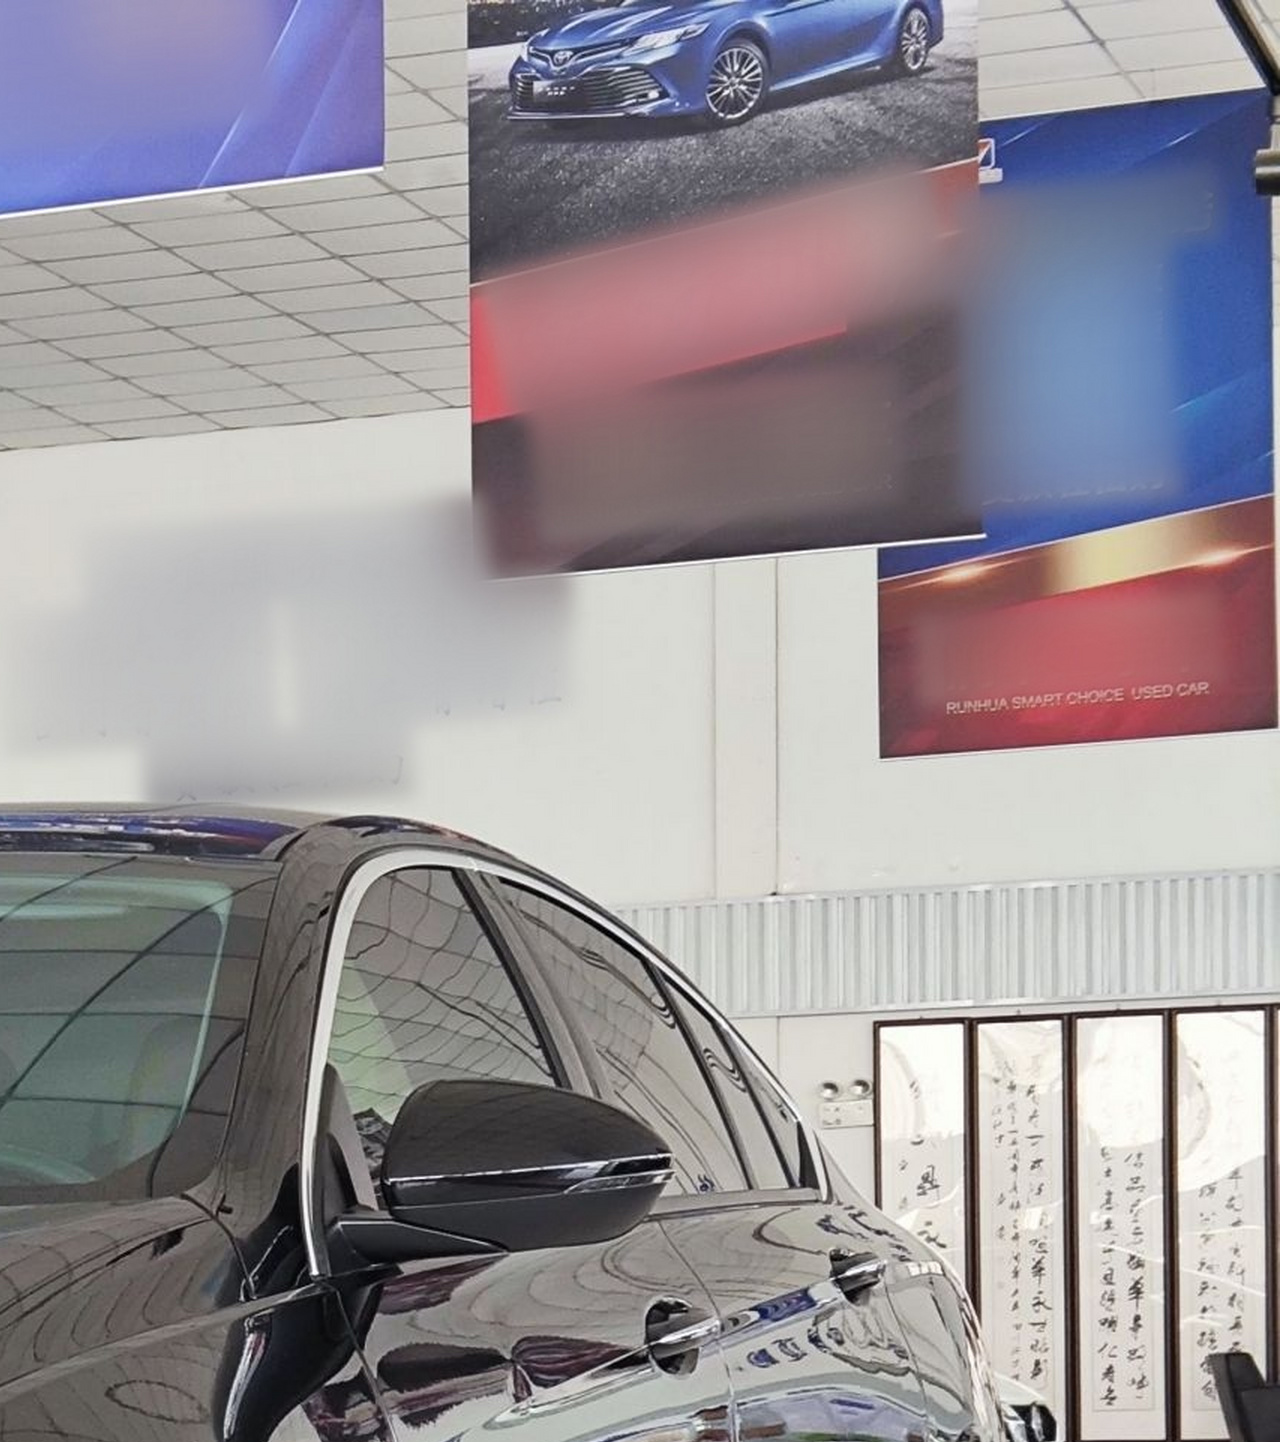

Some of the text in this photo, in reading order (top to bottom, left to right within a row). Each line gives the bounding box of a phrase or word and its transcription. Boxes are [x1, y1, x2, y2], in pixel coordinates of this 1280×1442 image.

[945, 681, 1211, 715] RUNHUA SMART CHOICE USED CAR
